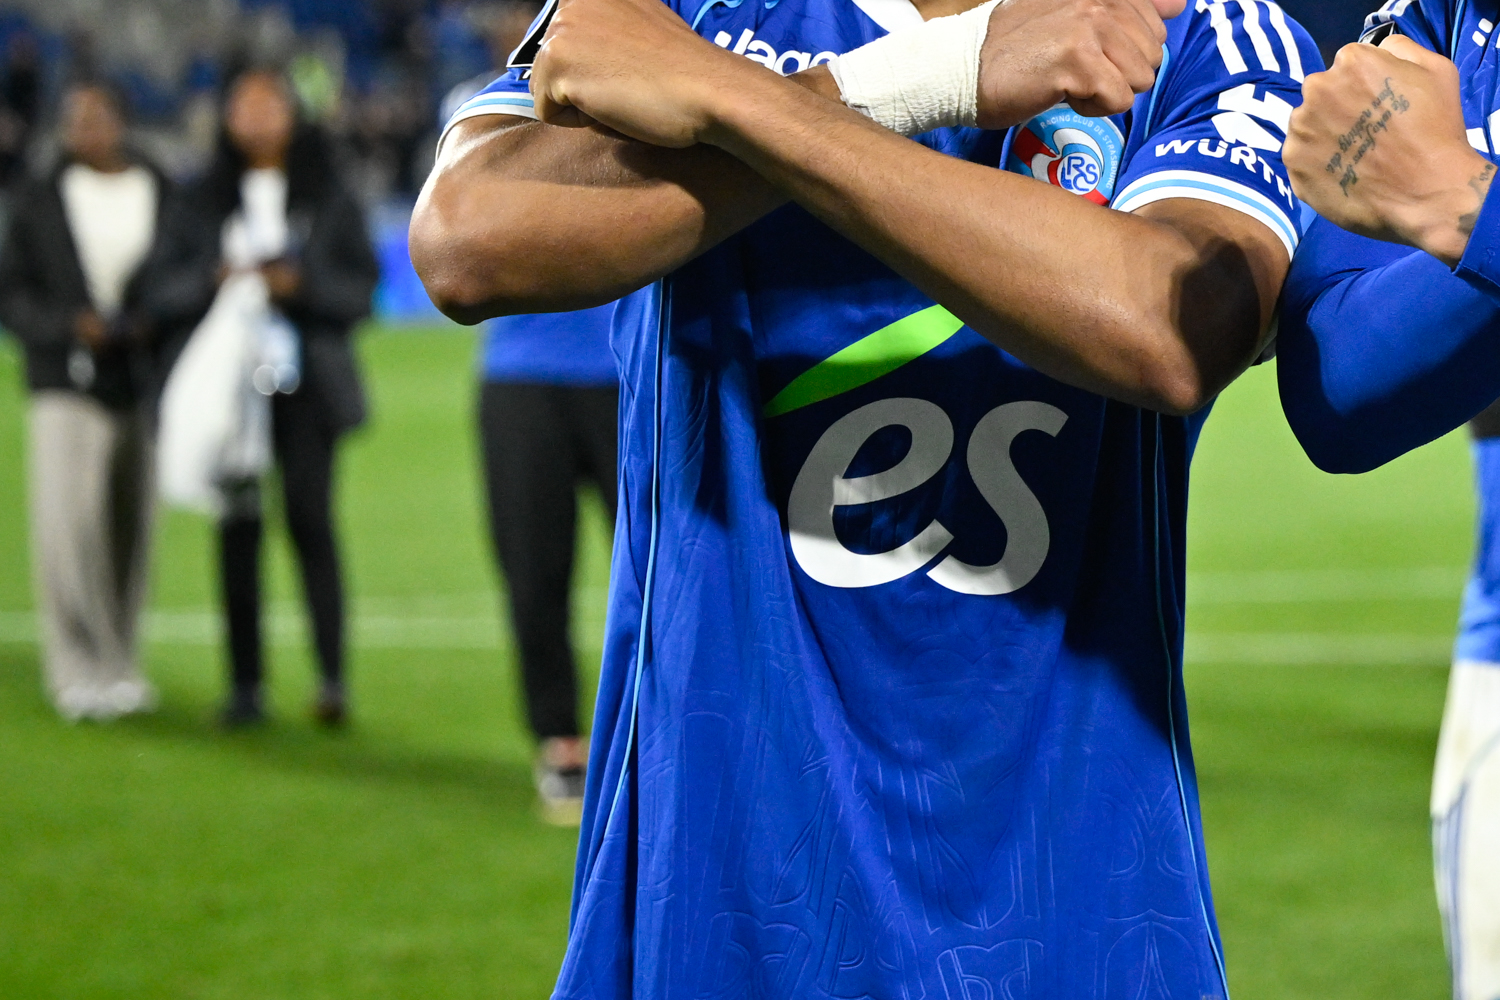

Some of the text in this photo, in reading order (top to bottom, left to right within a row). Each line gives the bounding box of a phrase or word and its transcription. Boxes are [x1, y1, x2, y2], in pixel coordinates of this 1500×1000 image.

[1040, 114, 1119, 189] RACING CLUB DE STRASBOURG
[1155, 138, 1294, 210] WÜRTH
[787, 397, 1069, 597] es
